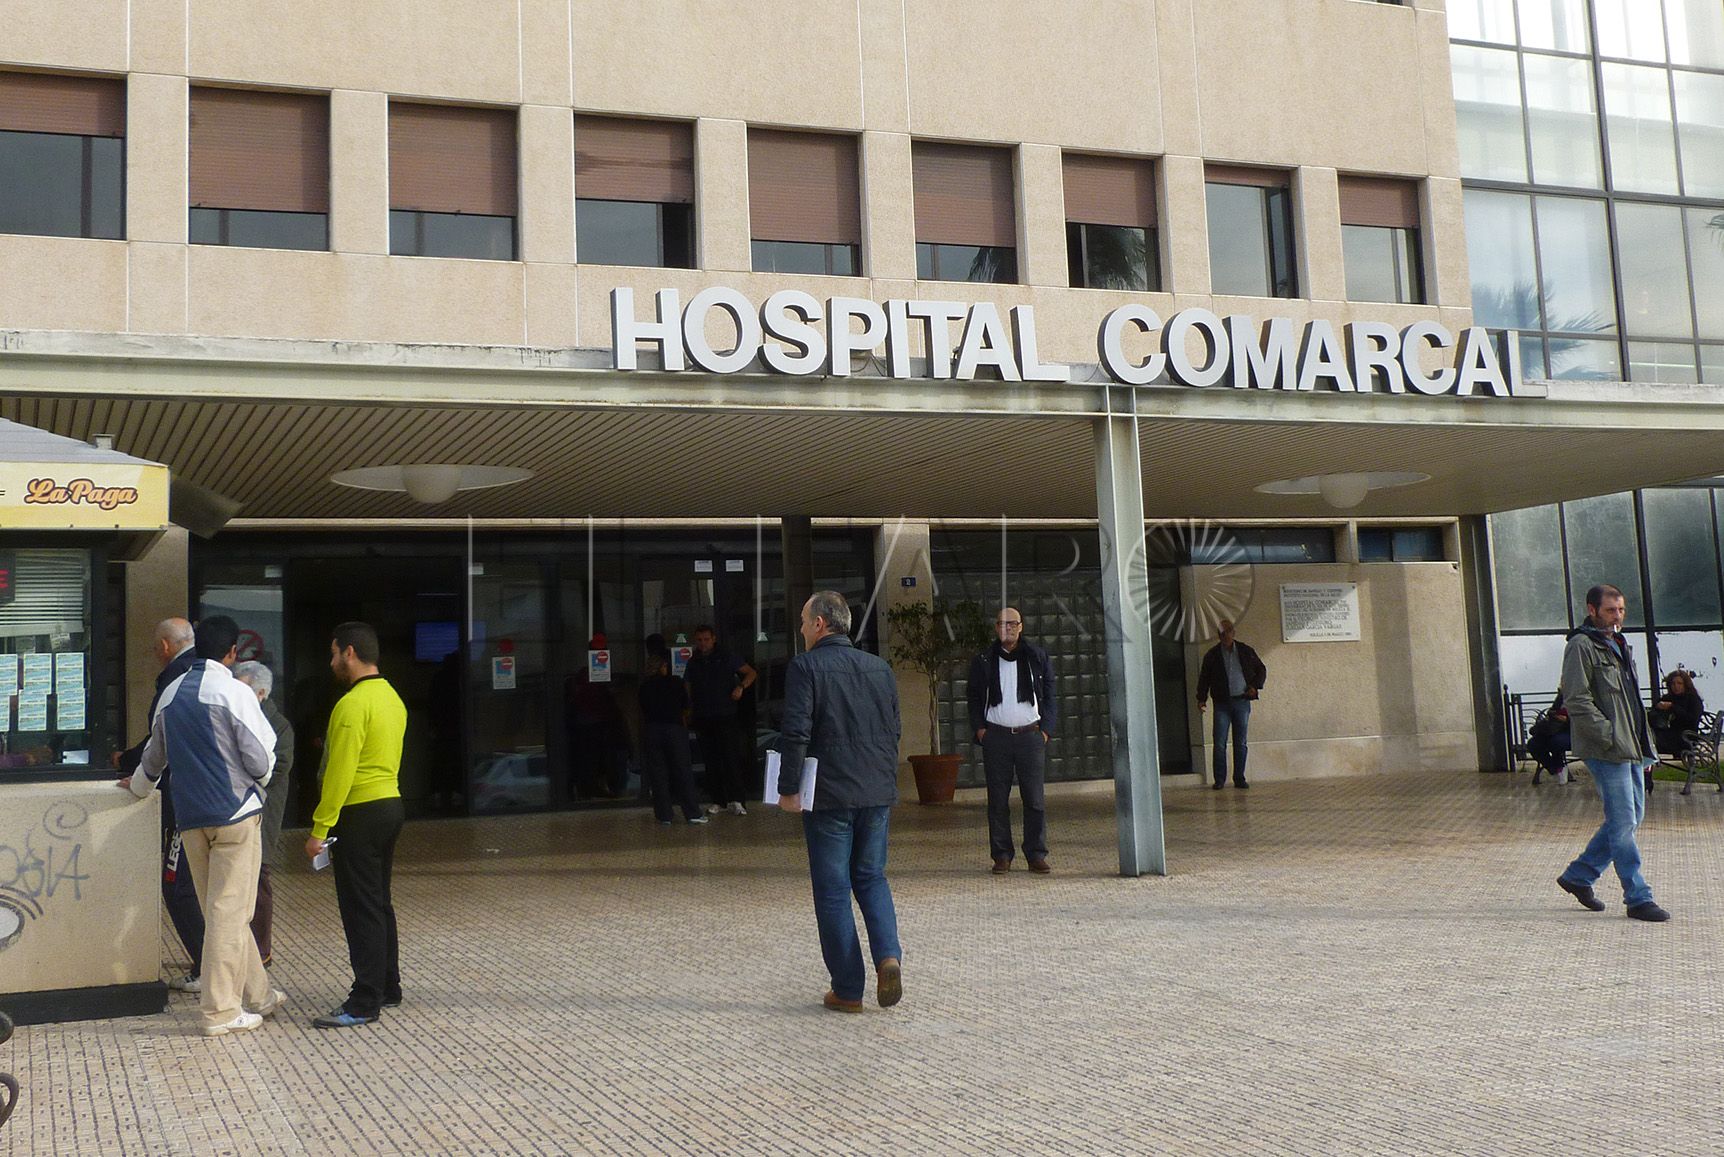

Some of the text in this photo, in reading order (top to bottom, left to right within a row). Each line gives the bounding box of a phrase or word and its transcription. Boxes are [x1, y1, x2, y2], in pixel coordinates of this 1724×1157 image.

[610, 286, 1548, 399] HOSPITAL COMARCAL
[24, 478, 138, 510] La Paga
